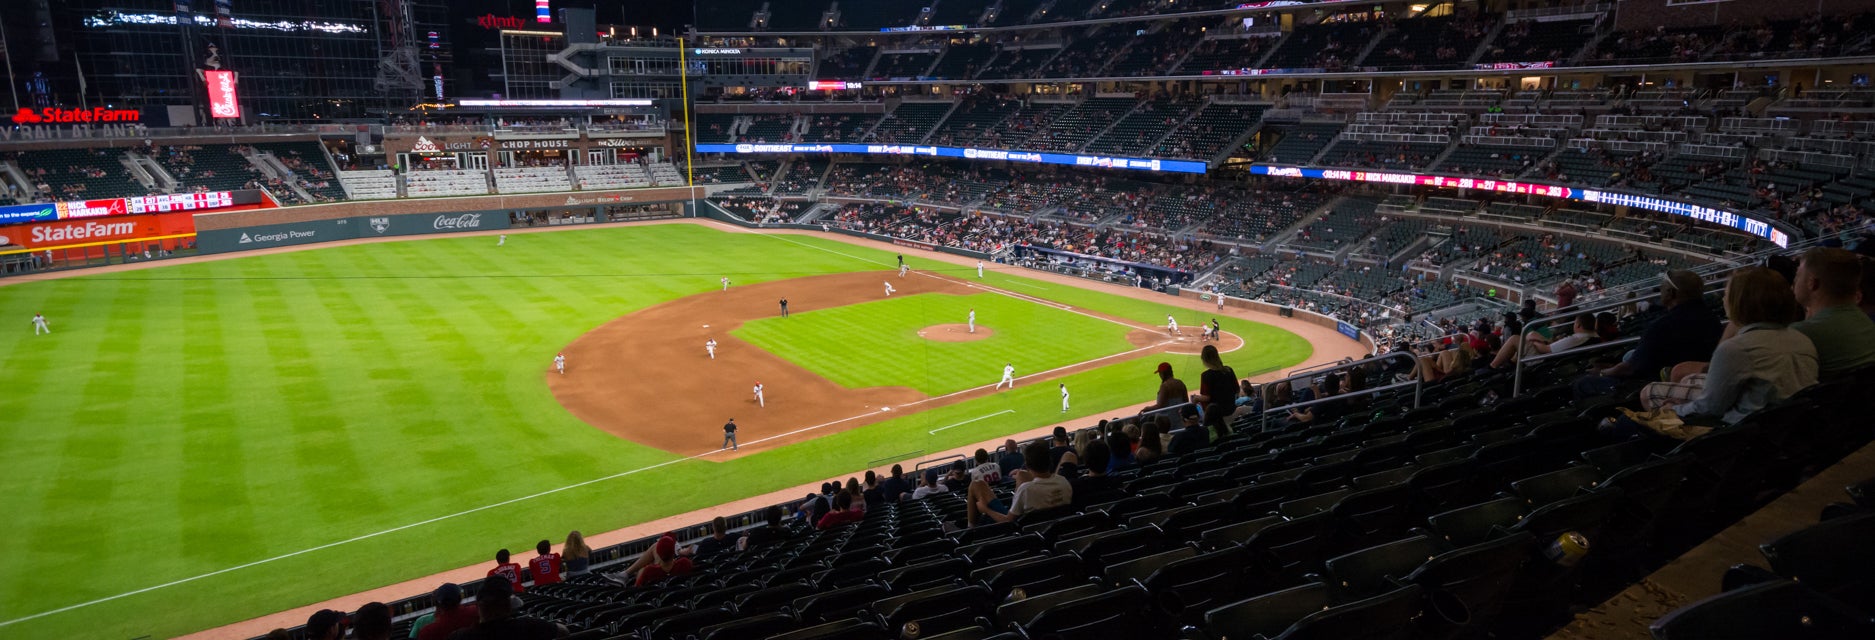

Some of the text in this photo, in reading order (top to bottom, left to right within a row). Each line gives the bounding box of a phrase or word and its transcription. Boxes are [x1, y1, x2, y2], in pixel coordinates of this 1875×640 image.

[478, 13, 526, 30] xfinity
[445, 142, 472, 150] LIGHT
[502, 139, 569, 149] CHOP HOUSE
[1325, 169, 1340, 179] 10:14
[1340, 170, 1351, 180] PM
[1356, 172, 1365, 180] 22
[1366, 173, 1382, 182] NICK
[1382, 173, 1416, 184] MARKAKIS
[1434, 176, 1444, 186] RF
[1484, 181, 1495, 190] 217
[1507, 182, 1517, 192] 29
[57, 200, 87, 210] 22 NICK
[69, 207, 108, 217] MARKAKIS
[433, 213, 482, 230] Coca-Cola
[254, 228, 316, 243] Georgia Power
